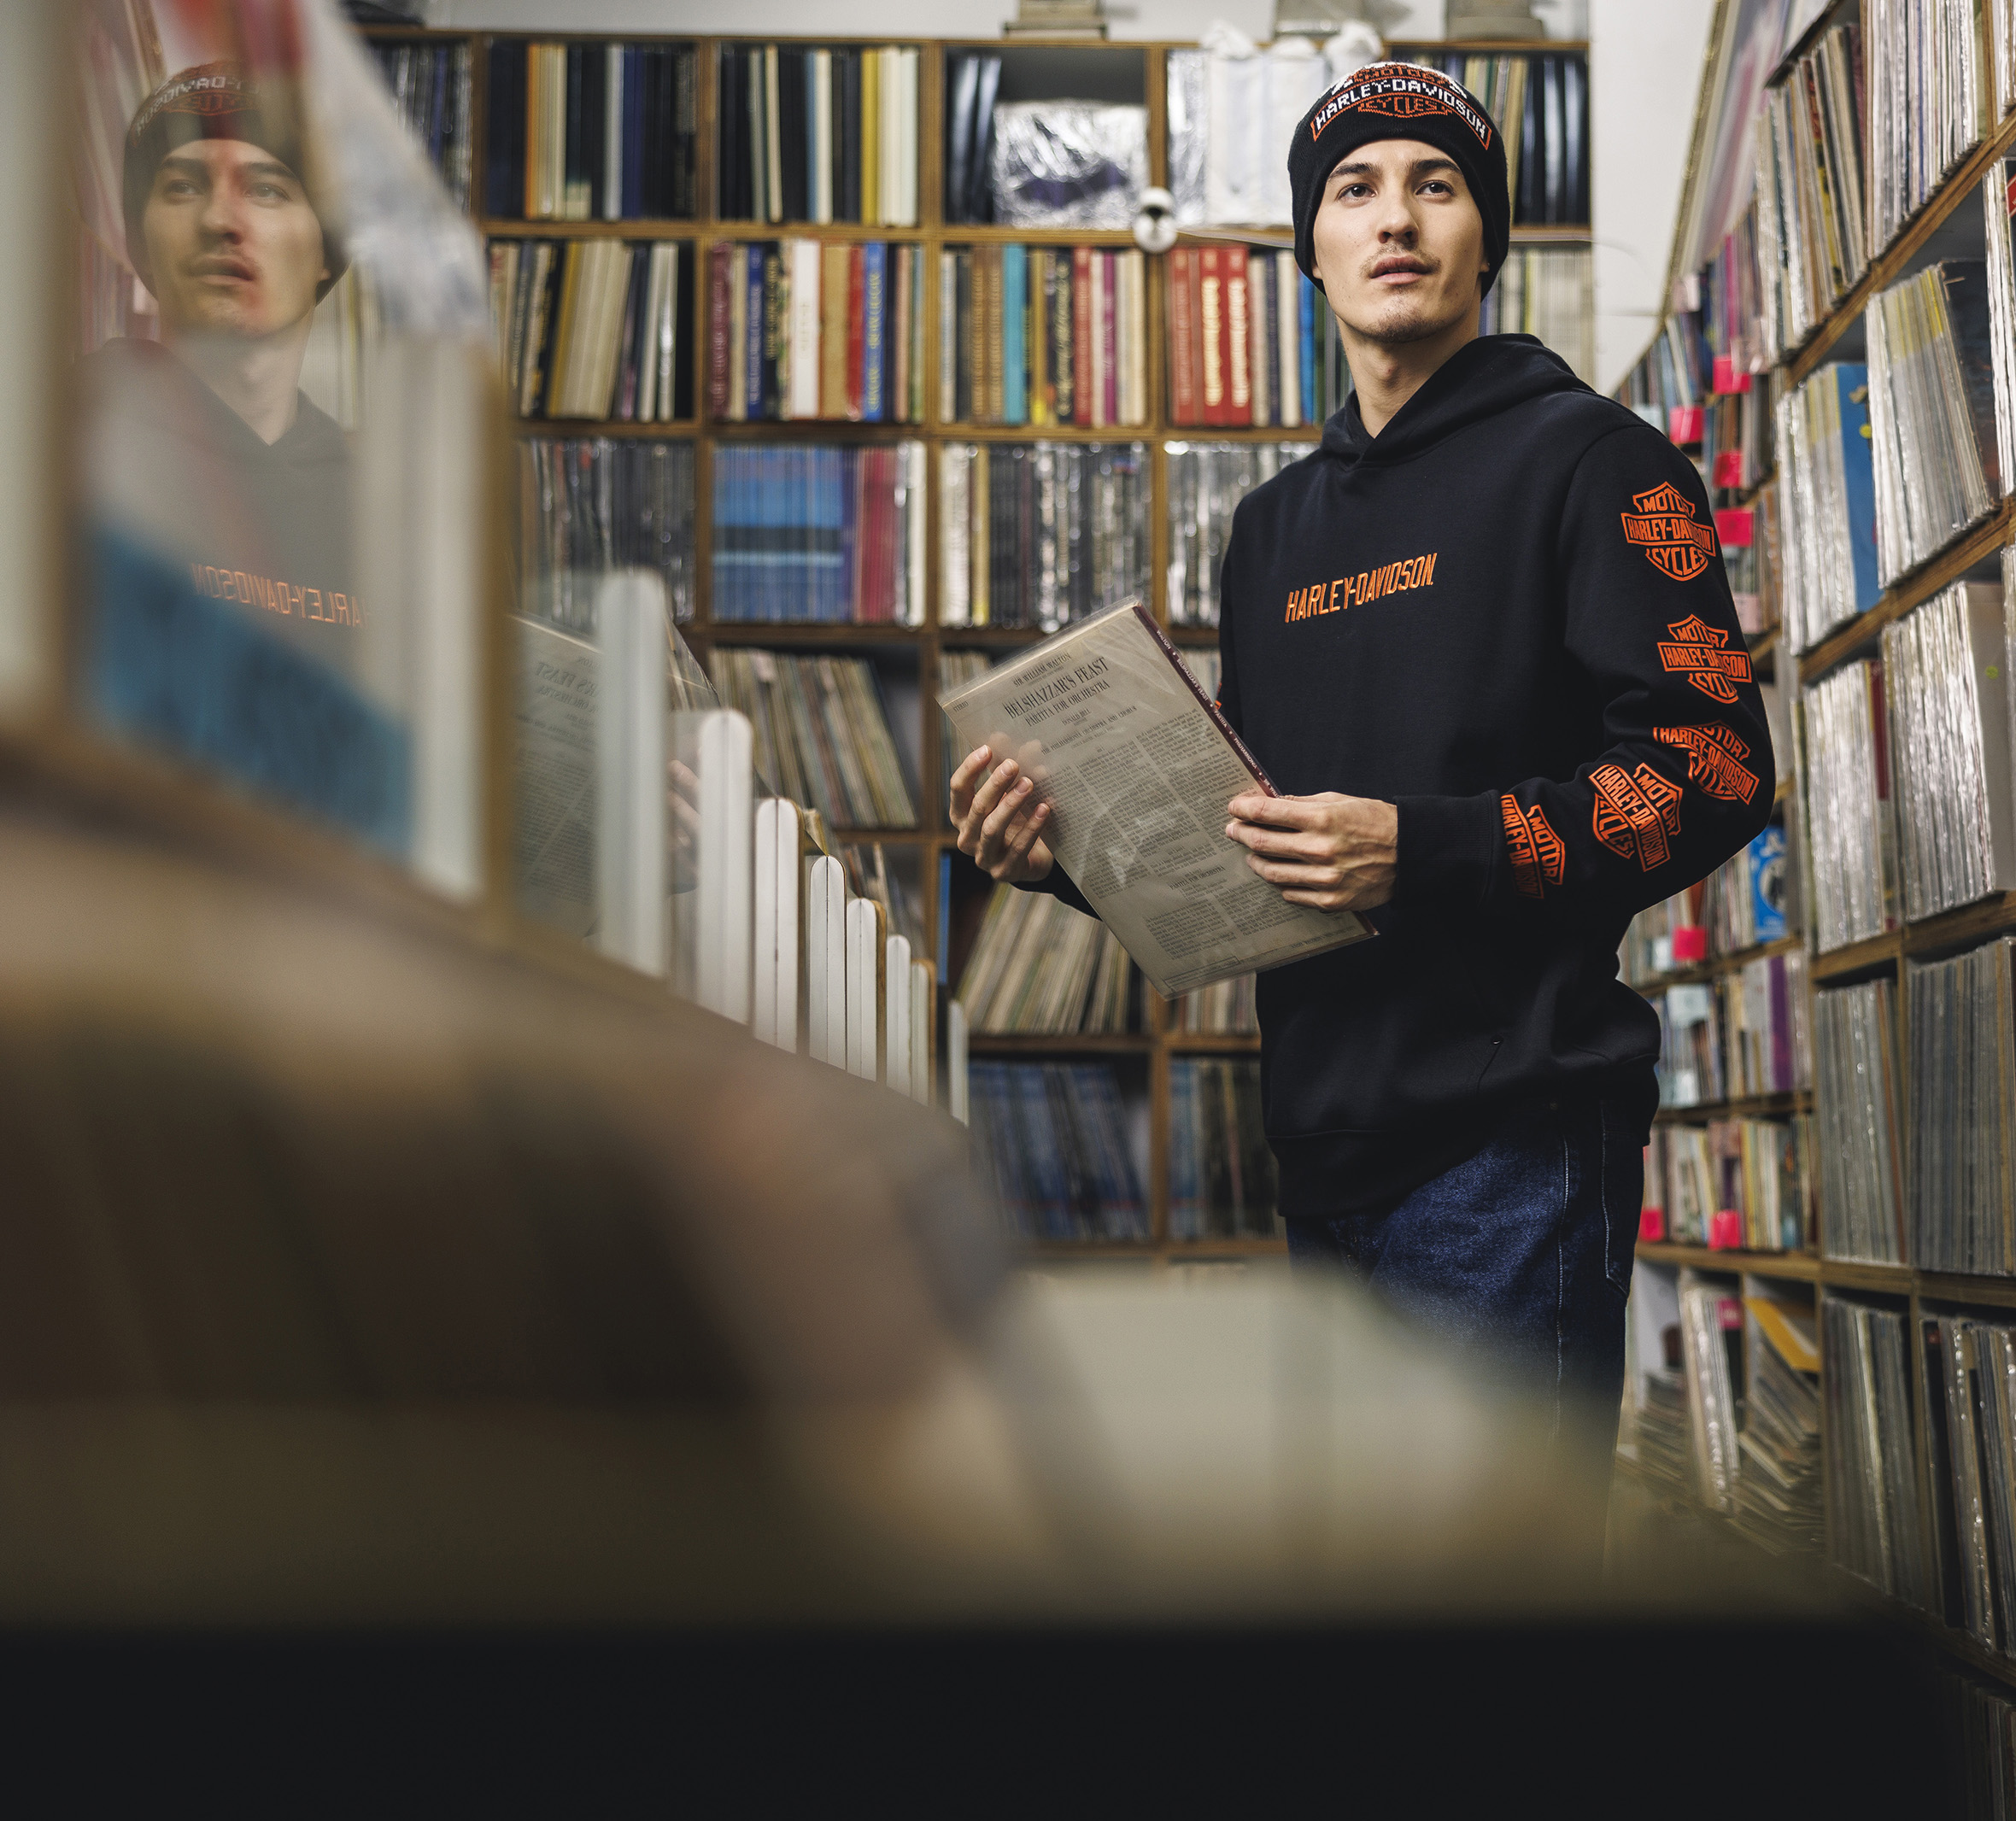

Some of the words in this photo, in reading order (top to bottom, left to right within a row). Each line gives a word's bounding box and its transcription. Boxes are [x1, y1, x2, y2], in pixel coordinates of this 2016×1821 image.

[1316, 79, 1486, 139] HARLEY-DAVIDSON
[1366, 97, 1438, 114] CYCLES
[1652, 547, 1706, 576] CYCLES
[1285, 553, 1438, 624] HARLEY-DAVIDSON
[1157, 630, 1172, 649] WALTON
[1003, 674, 1077, 719] BELSHAZZAR'S
[1074, 656, 1110, 683] FEAST
[1022, 663, 1047, 683] WILLIAM
[1046, 653, 1072, 670] WALTON
[1695, 672, 1738, 698] CYCL
[1024, 707, 1056, 727] PARTITA
[1052, 700, 1070, 714] FOR
[1068, 680, 1111, 706] ORCHESTRA
[1660, 727, 1755, 798] HARLEY-DAVIDSON
[1702, 725, 1743, 758] OTOR
[1596, 766, 1666, 866] HARLEY-DAVIDSON
[1637, 773, 1679, 832] MOTOR
[1529, 817, 1562, 878] MOTOR
